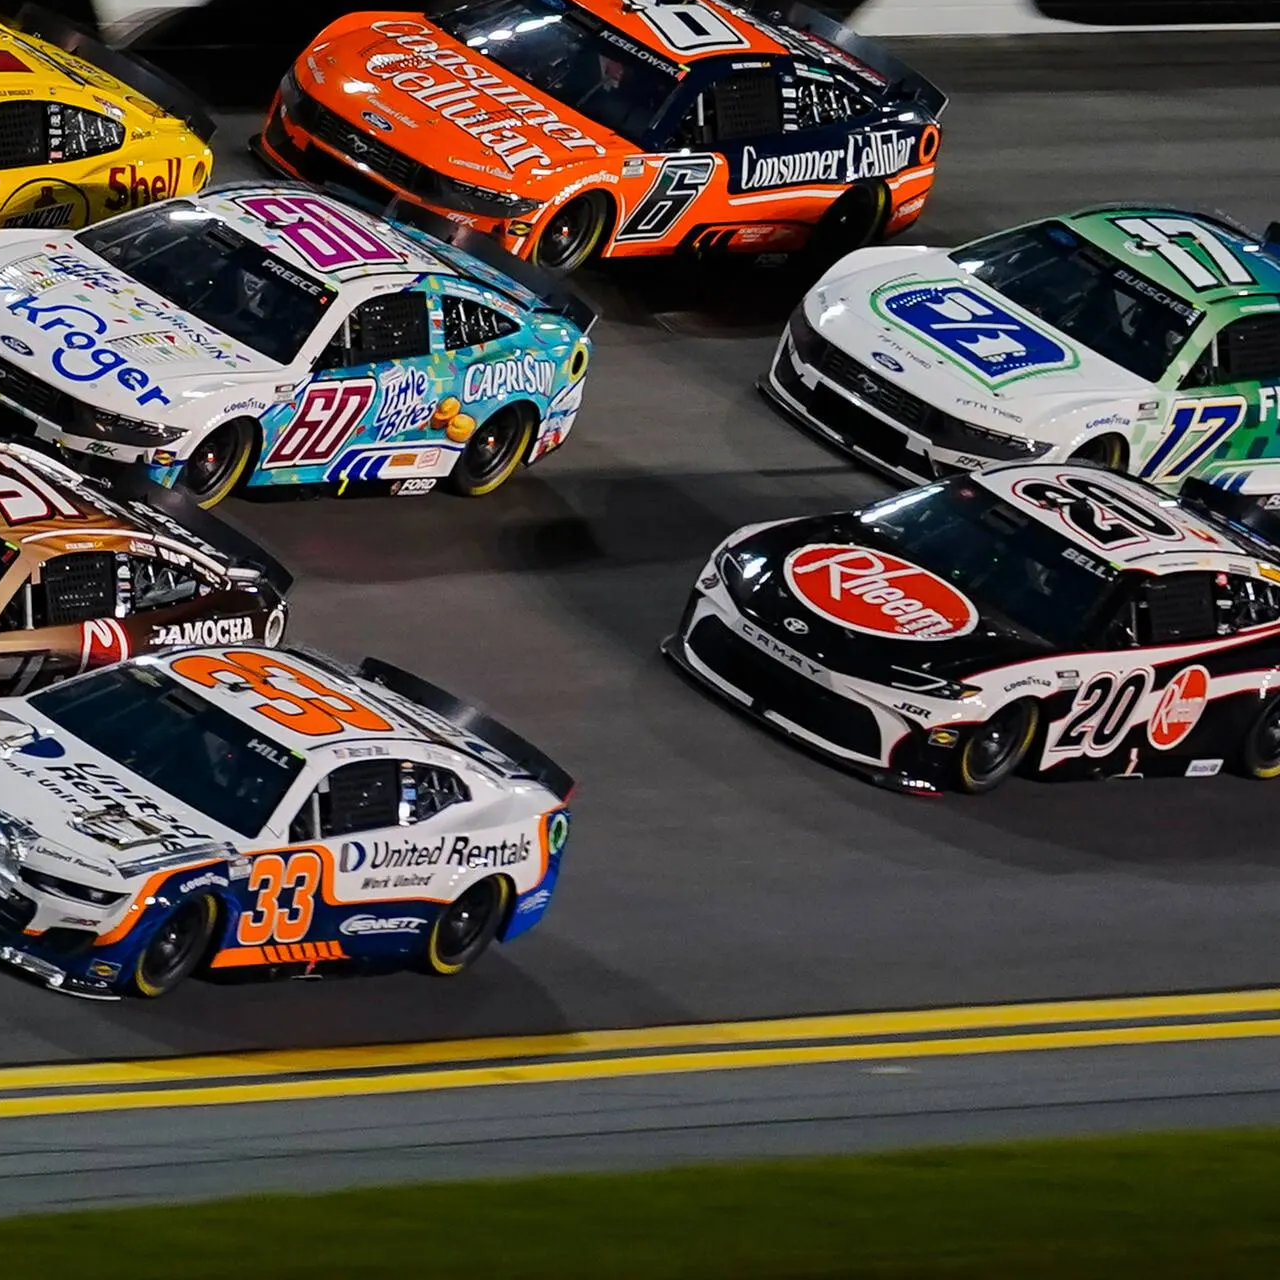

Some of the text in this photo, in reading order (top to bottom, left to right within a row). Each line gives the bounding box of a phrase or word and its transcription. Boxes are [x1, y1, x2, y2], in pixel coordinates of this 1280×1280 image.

[365, 52, 553, 172] Cellular
[370, 21, 607, 156] Consumer
[104, 158, 182, 210] Shell
[741, 129, 916, 189] Consumer Cellular
[238, 196, 406, 269] 60
[614, 153, 715, 243] 6
[261, 258, 323, 297] PREECE
[1108, 217, 1258, 292] 17
[7, 295, 171, 407] Kroger
[263, 380, 377, 466] 60
[1139, 397, 1247, 483] 17
[401, 478, 437, 491] FORD
[1018, 475, 1181, 549] 20
[793, 550, 953, 640] Rheem
[1061, 547, 1111, 580] BELL
[151, 617, 254, 646] JAMOCHA
[170, 651, 395, 736] 33
[893, 701, 933, 720] JGR
[1054, 667, 1153, 755] 20
[246, 737, 291, 770] HILL
[371, 833, 532, 870] United Rentals
[237, 852, 323, 946] 33
